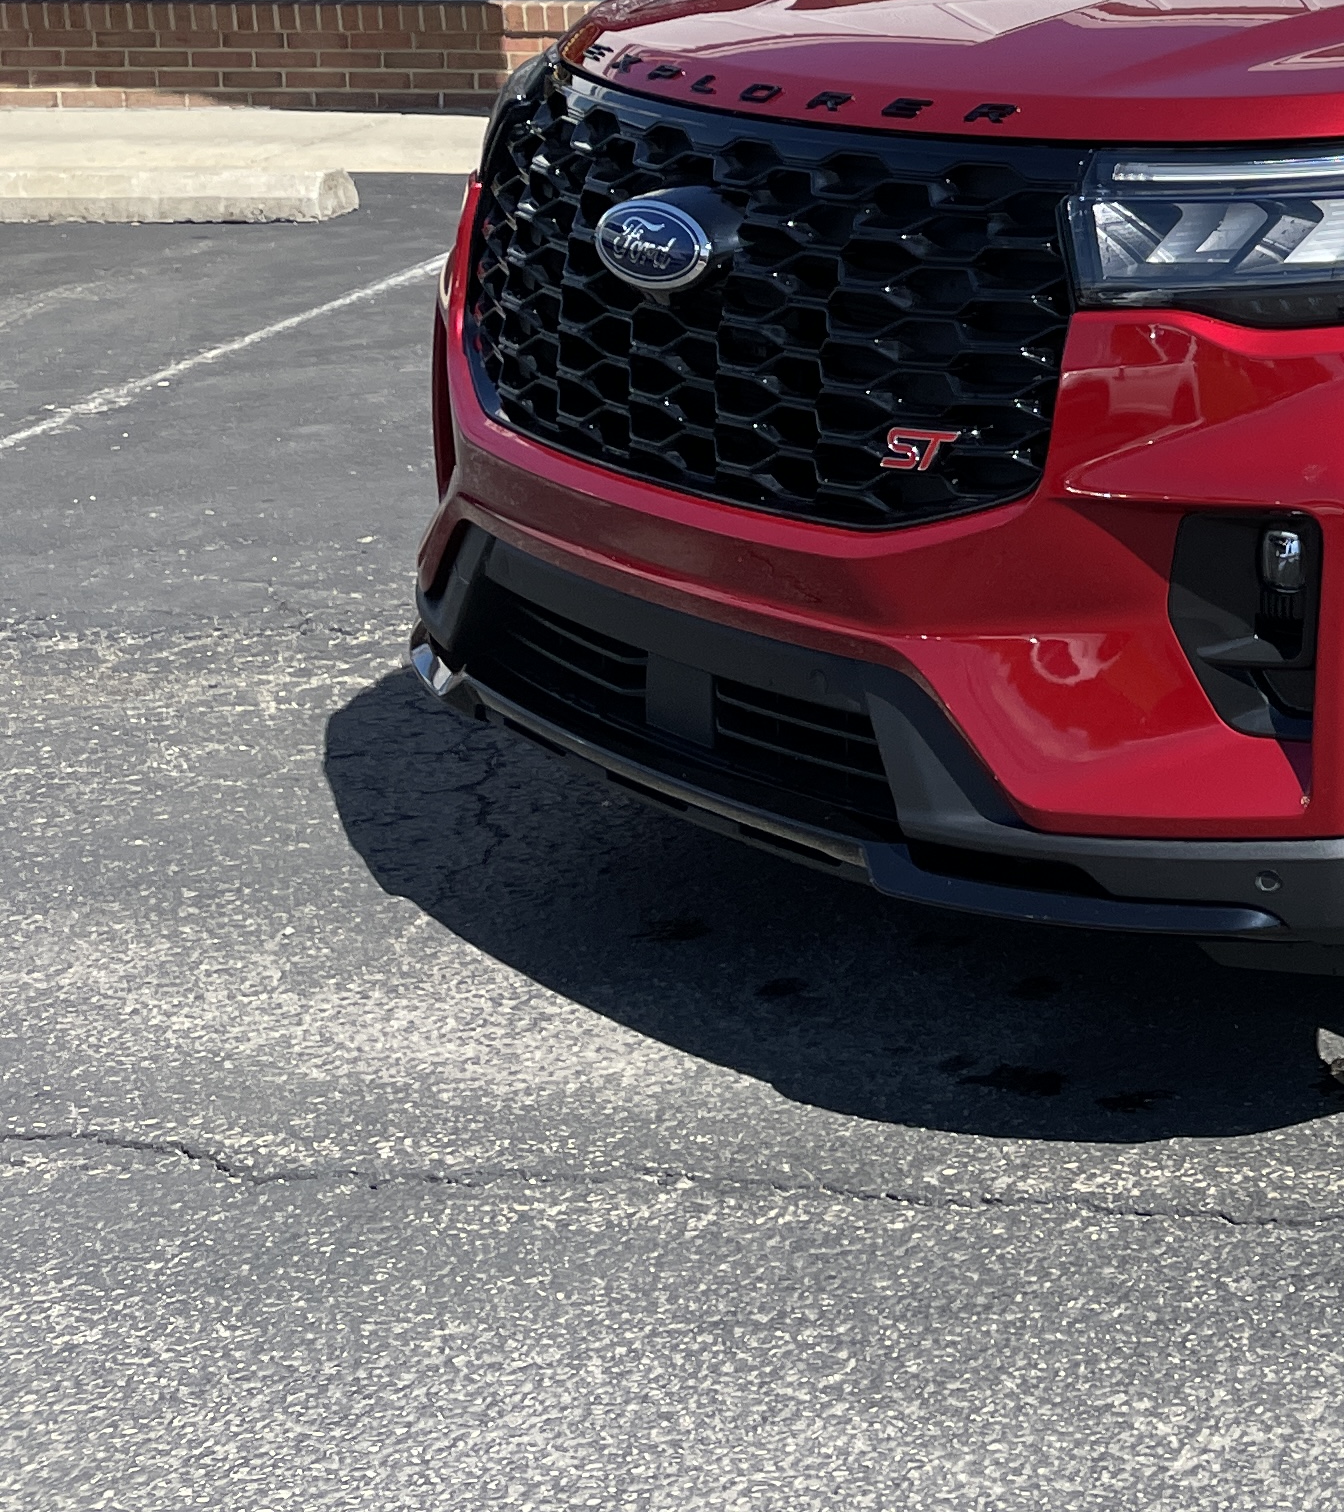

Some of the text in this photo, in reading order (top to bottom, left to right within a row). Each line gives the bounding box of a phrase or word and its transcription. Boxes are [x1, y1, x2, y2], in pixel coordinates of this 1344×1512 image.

[583, 43, 1021, 124] EXPLORER
[613, 216, 677, 269] Ford
[880, 427, 961, 471] ST
